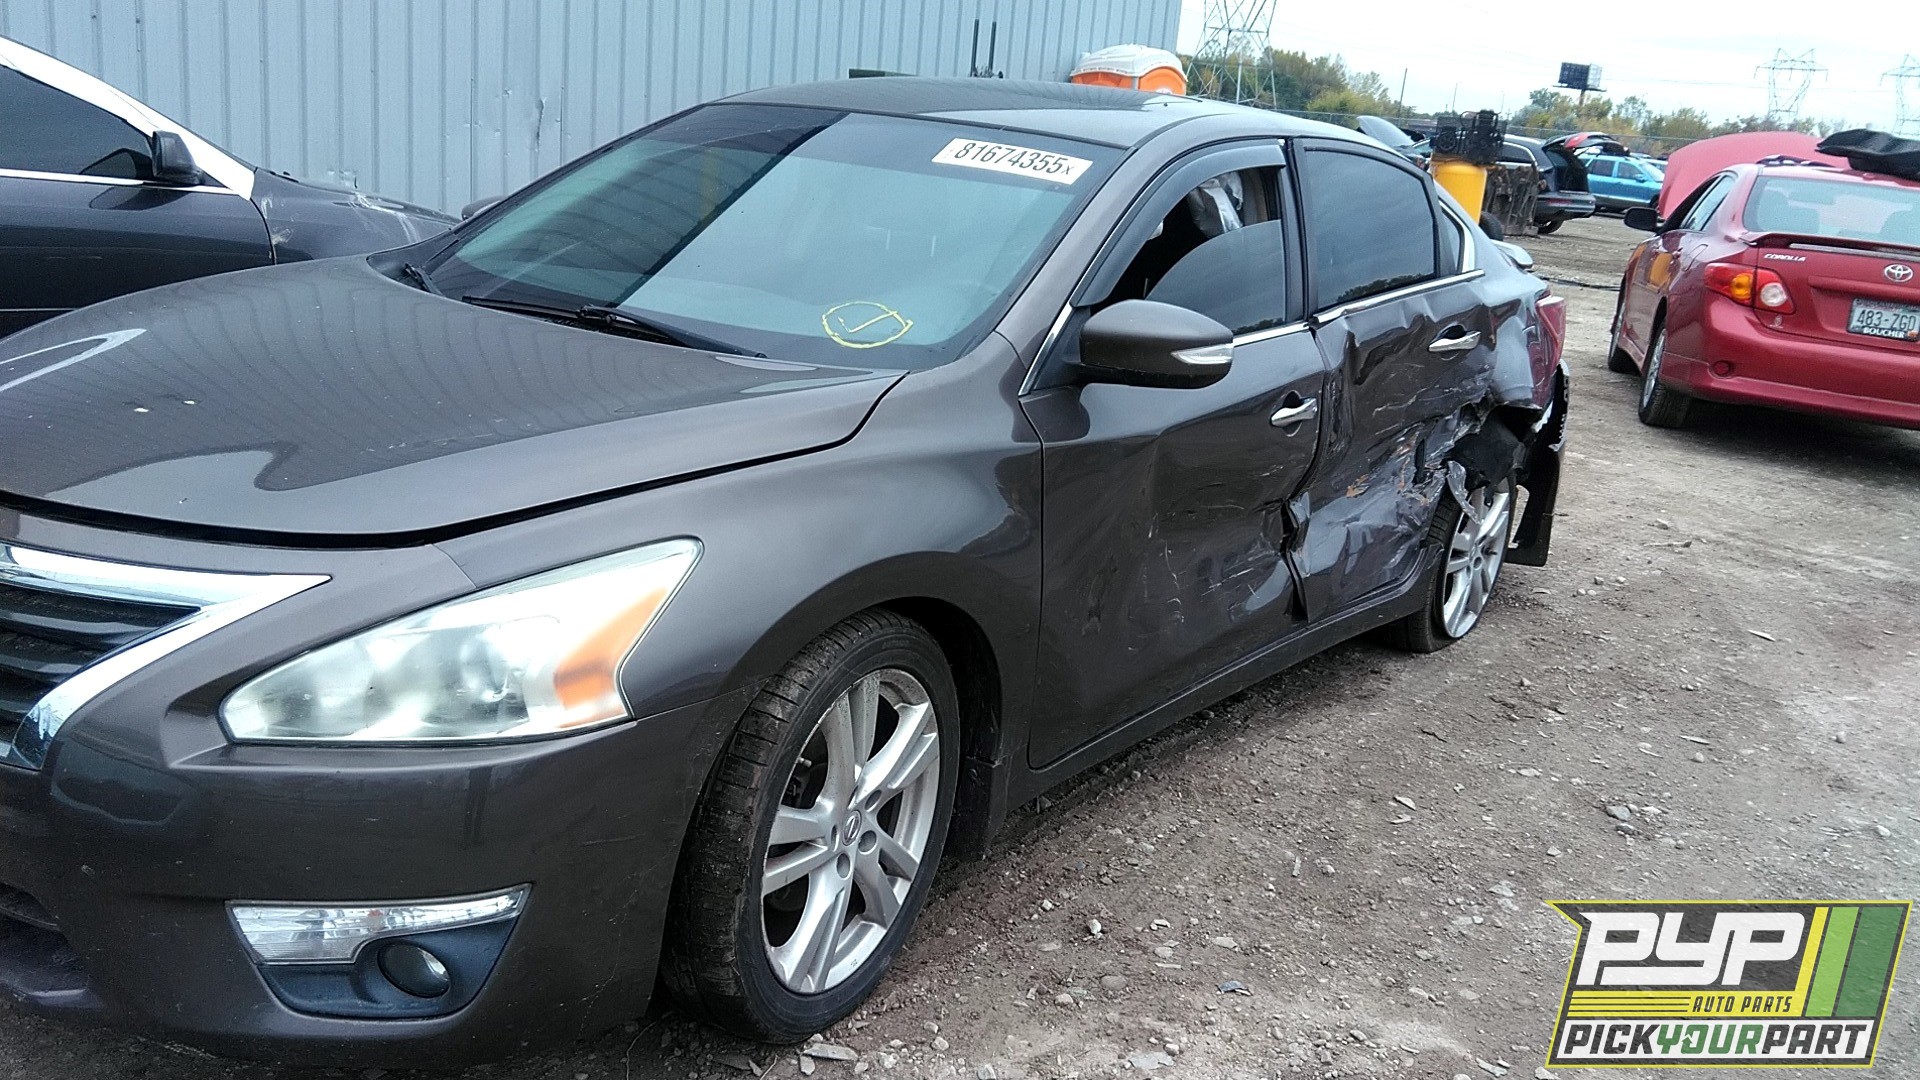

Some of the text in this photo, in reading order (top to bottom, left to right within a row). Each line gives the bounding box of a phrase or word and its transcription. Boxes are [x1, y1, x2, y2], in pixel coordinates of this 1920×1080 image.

[1764, 253, 1806, 262] COROLLA
[1857, 309, 1917, 331] 483-ZGD
[1863, 327, 1905, 338] BOUCHER
